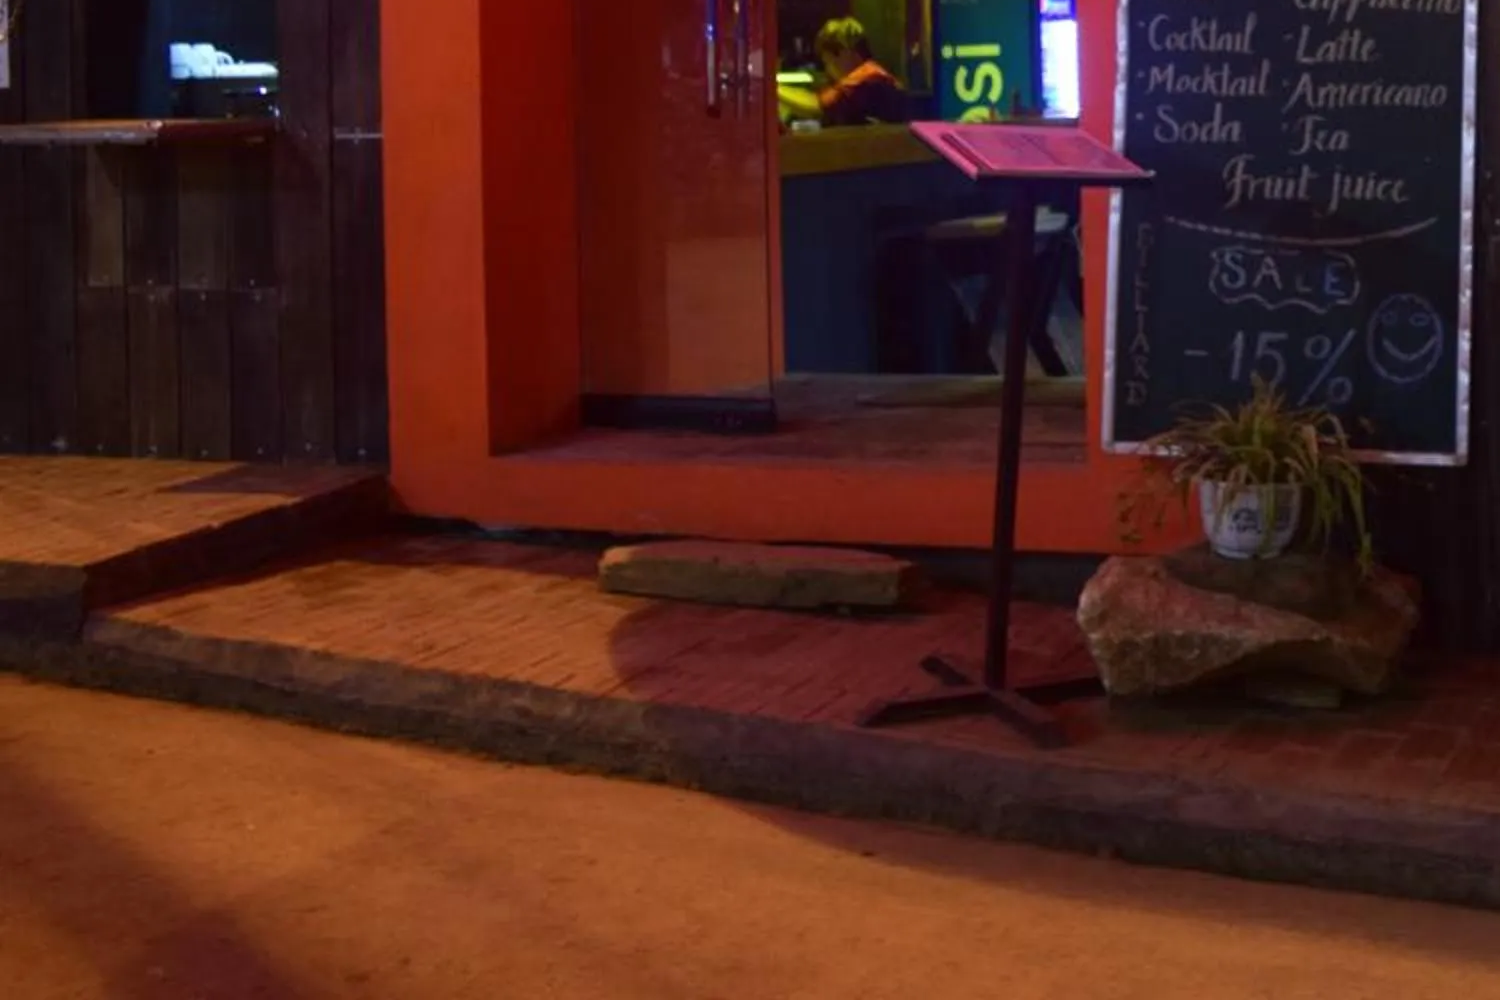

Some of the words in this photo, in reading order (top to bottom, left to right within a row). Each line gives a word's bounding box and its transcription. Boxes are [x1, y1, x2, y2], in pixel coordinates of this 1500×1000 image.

[1148, 12, 1258, 54] Cocktail
[1296, 25, 1379, 63] Latte
[1144, 59, 1271, 97] Mocktail
[1281, 72, 1448, 114] Americano
[1153, 102, 1243, 143] Soda
[1289, 115, 1350, 156] Tea
[1222, 155, 1320, 208] Fruit
[1326, 165, 1409, 214] juice
[1220, 250, 1346, 296] SALE
